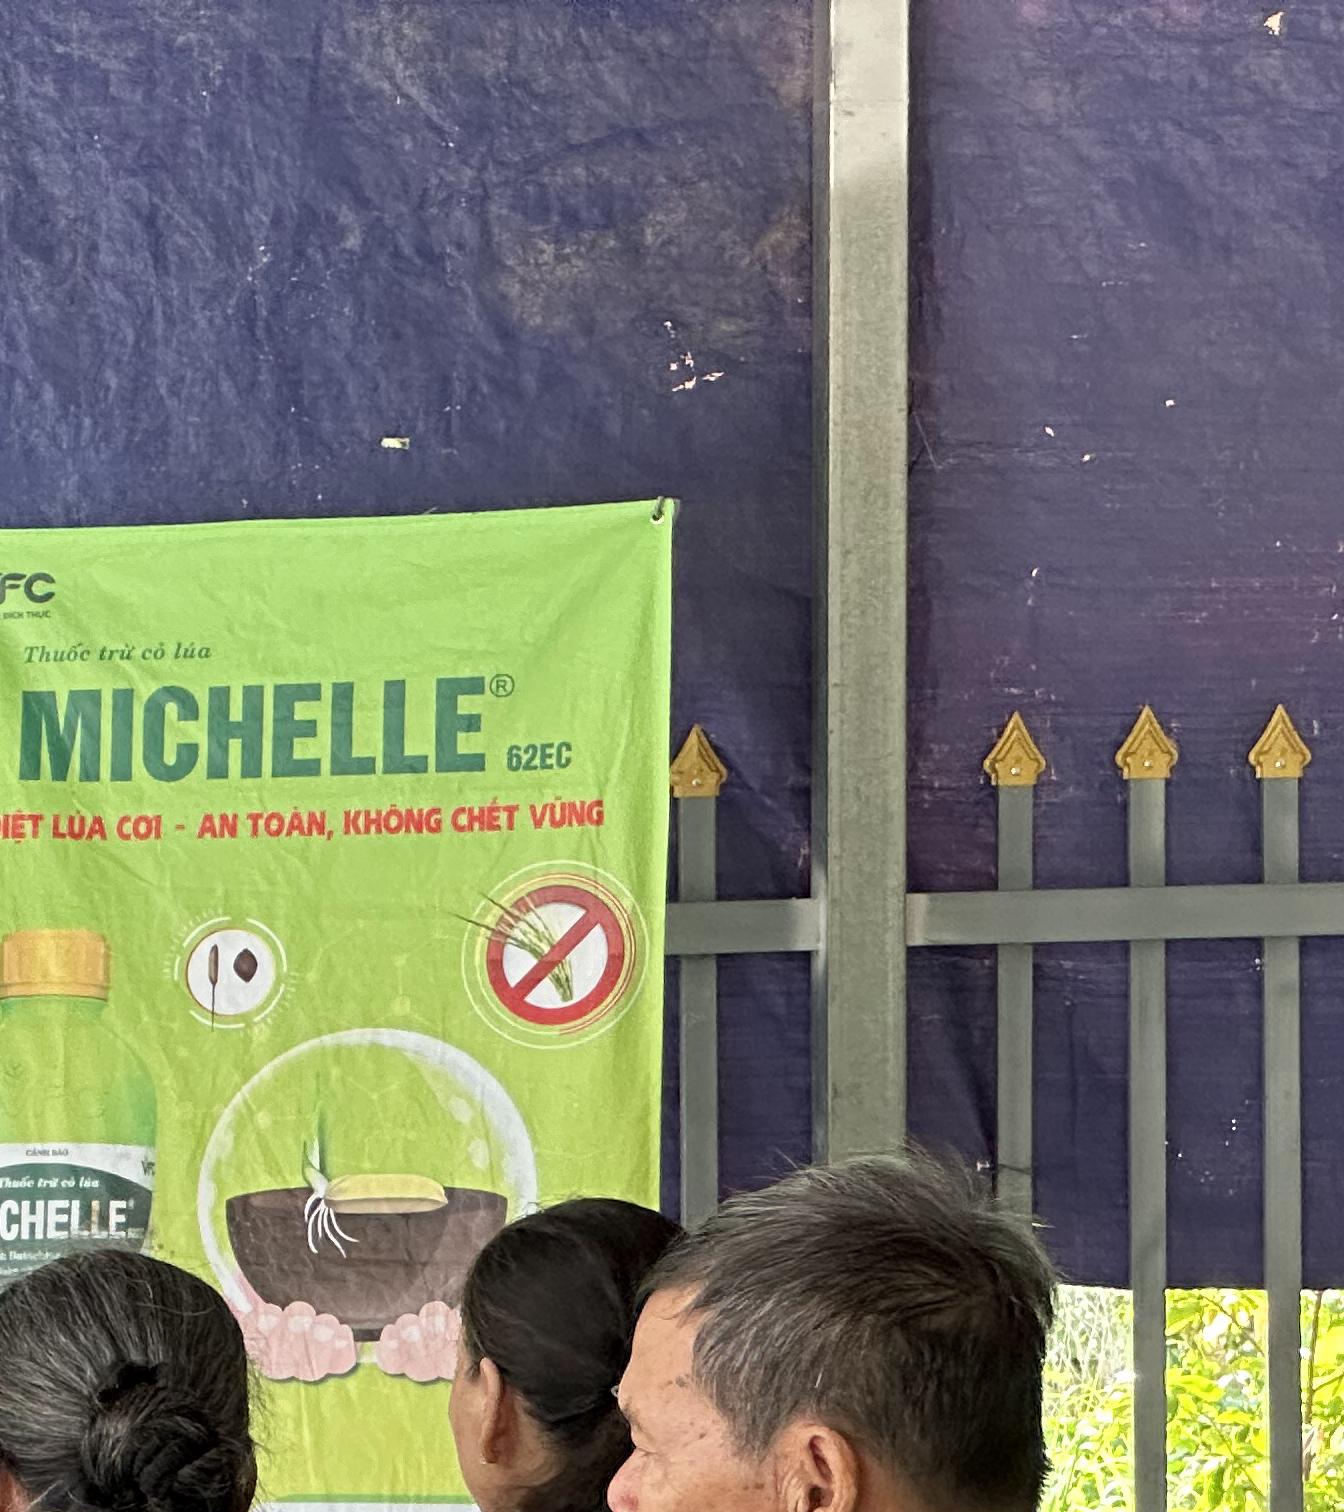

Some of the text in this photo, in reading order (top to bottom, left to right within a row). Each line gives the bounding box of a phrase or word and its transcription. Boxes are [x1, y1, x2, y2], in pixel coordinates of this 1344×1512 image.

[24, 641, 212, 664] Thuốc trừ cỏ lúa
[506, 741, 573, 771] 62EC
[197, 811, 239, 840] AN
[246, 805, 334, 841] TOÀN,
[342, 803, 443, 836] KHÔNG
[450, 796, 520, 833] CHẾT
